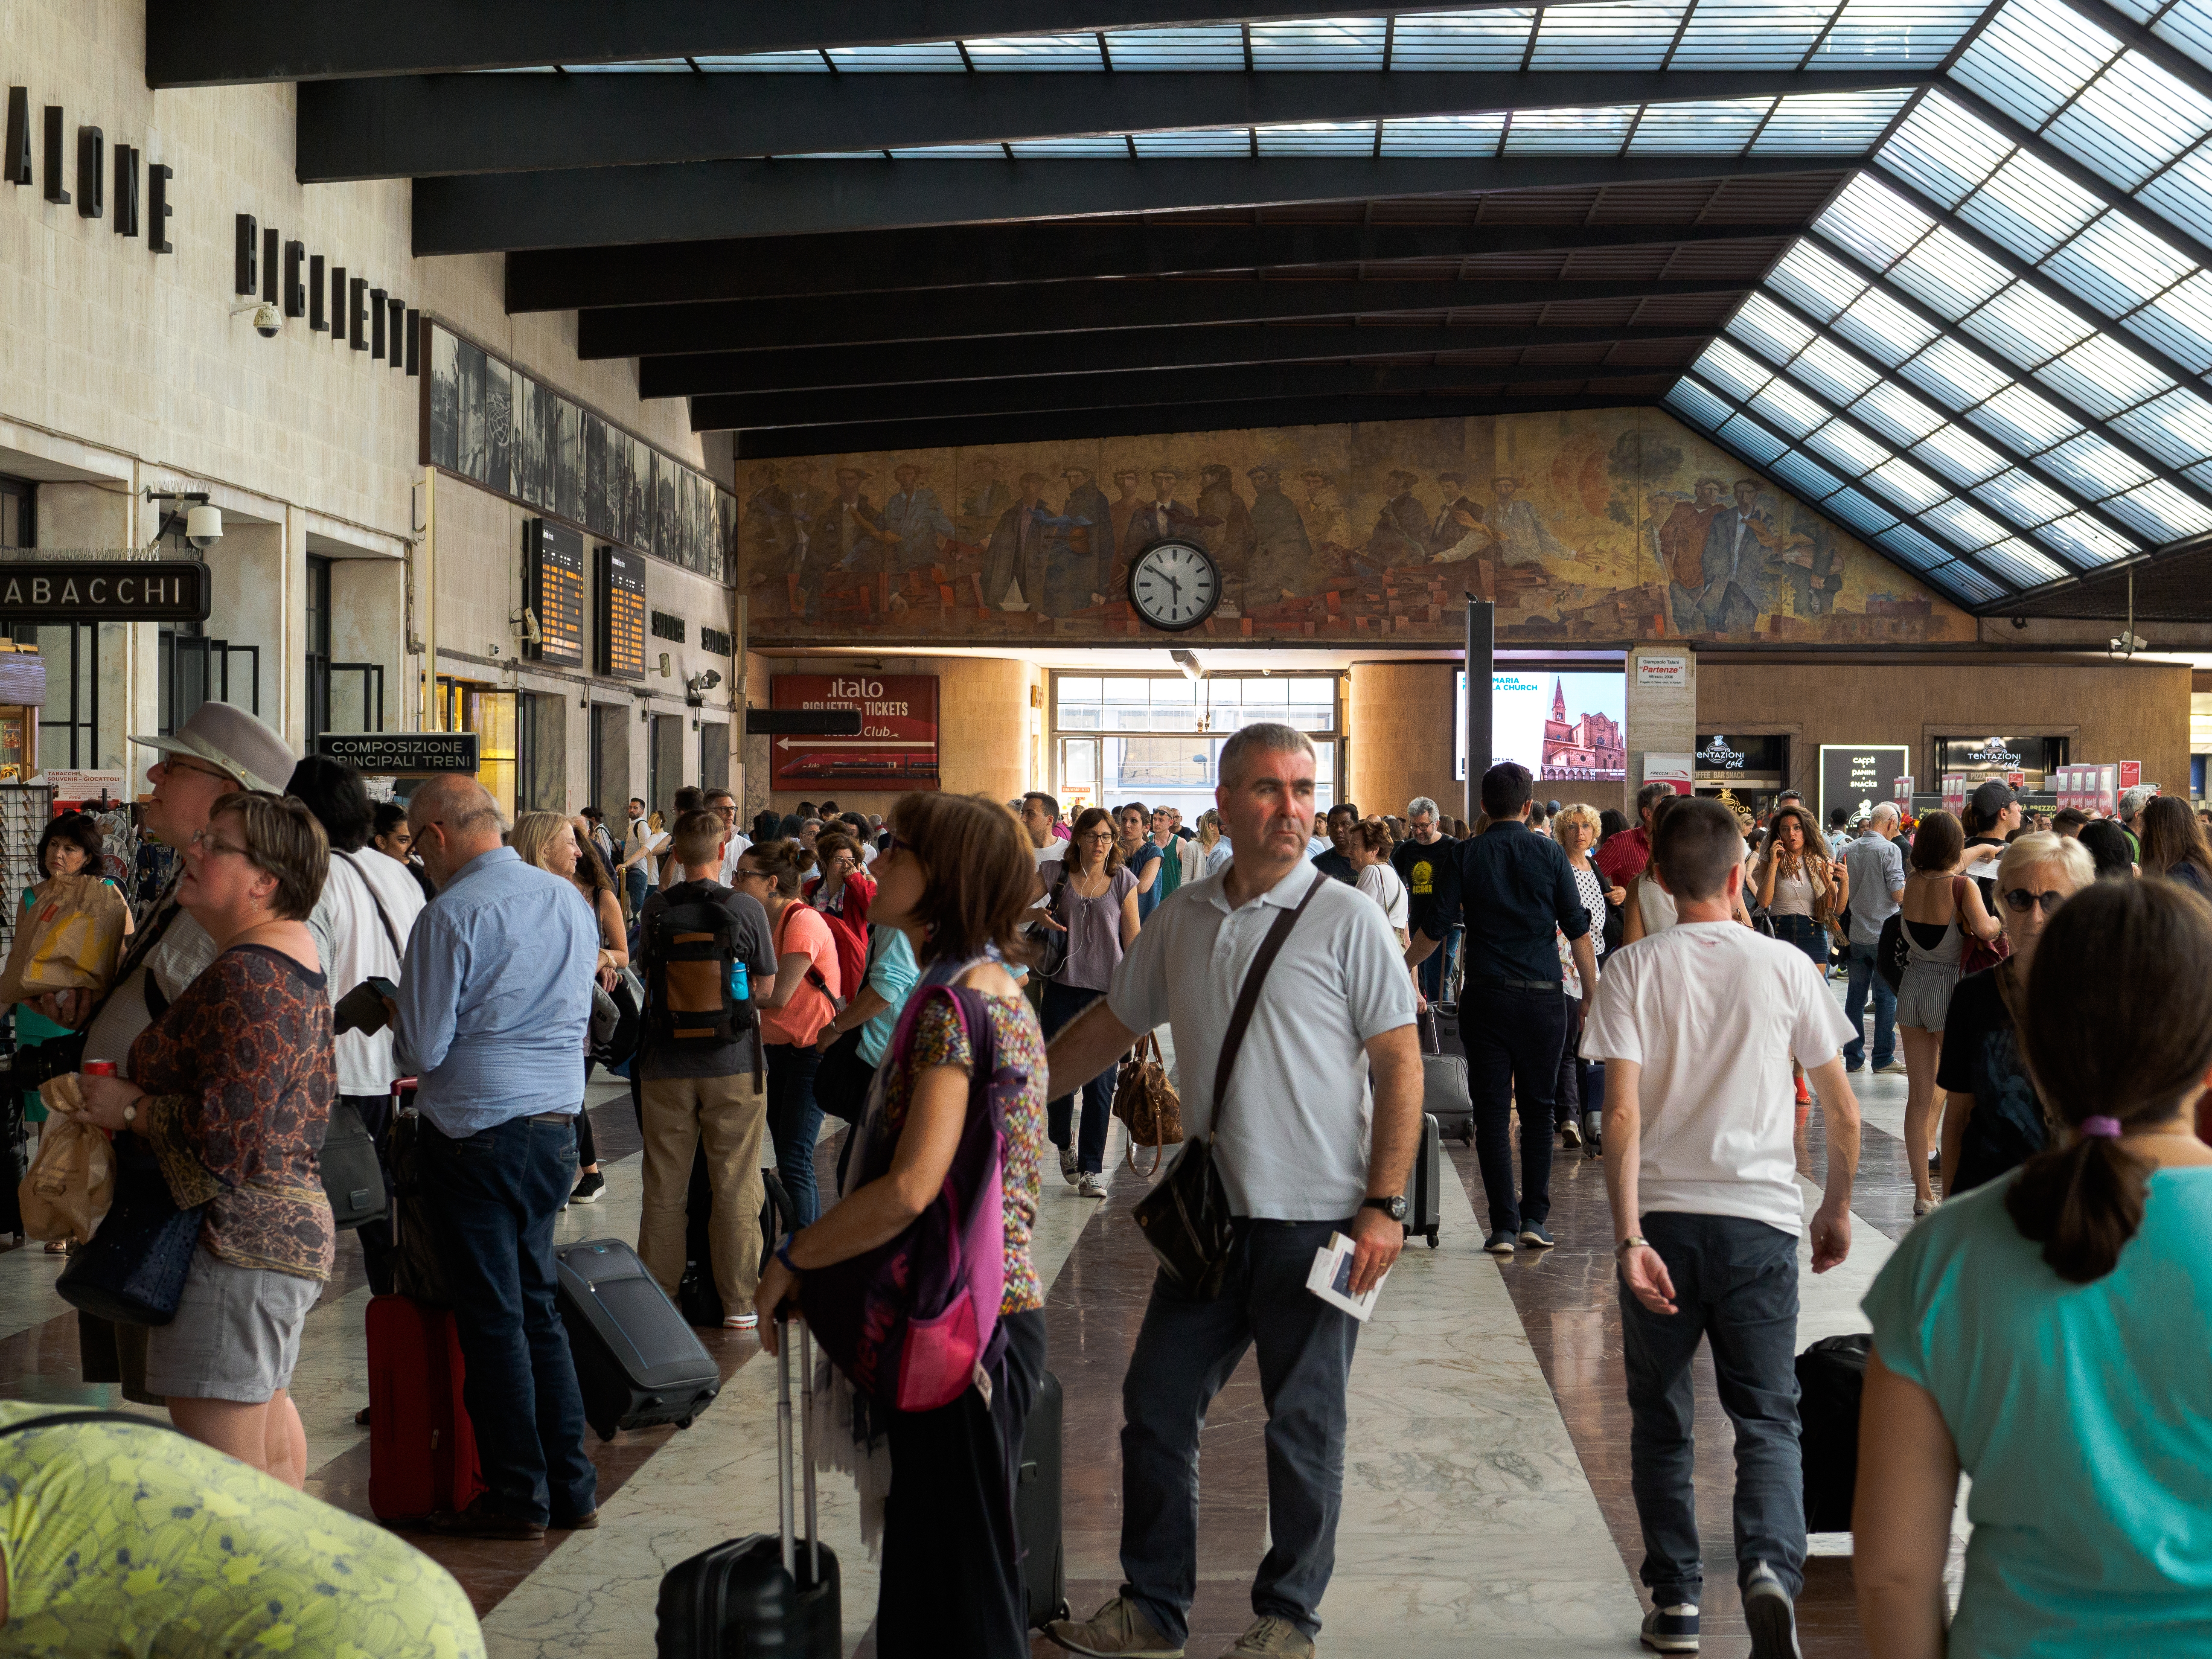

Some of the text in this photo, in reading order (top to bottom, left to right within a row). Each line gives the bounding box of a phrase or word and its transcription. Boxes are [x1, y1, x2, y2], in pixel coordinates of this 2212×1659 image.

[4, 86, 420, 376] ALONE BIGLIETTI
[4, 578, 179, 604] ABACCHI
[864, 702, 908, 716] TICKETS
[864, 726, 891, 736] Club
[332, 742, 463, 753] COMPOSIZIONE
[423, 756, 470, 767] TRENI
